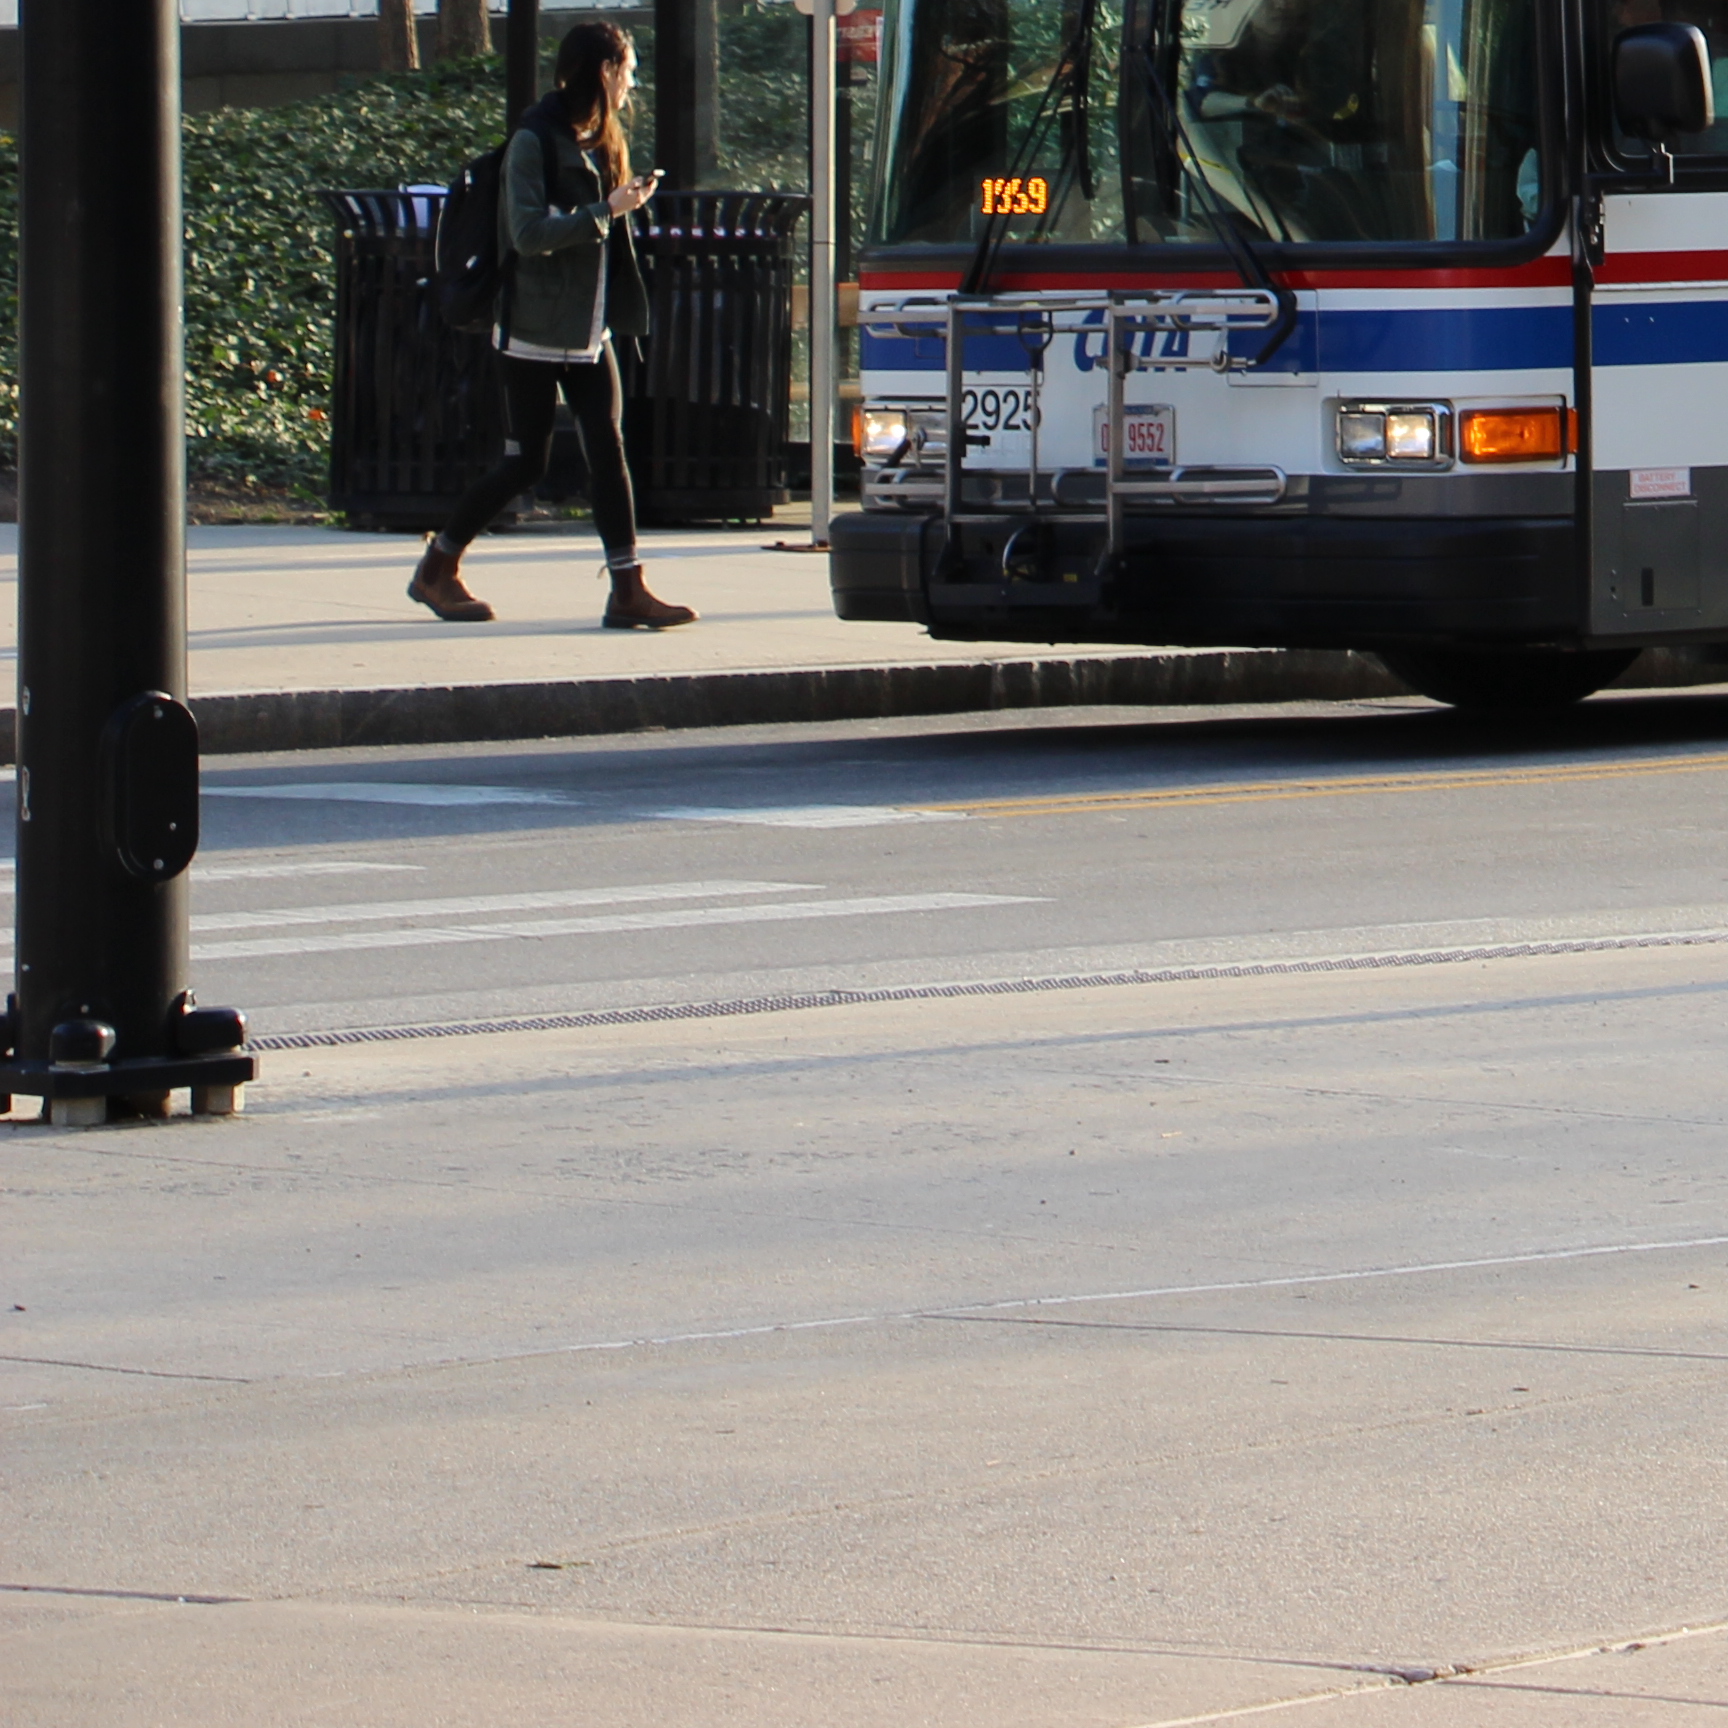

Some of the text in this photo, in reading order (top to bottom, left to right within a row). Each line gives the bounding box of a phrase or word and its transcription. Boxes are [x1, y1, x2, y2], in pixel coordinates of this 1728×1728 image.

[962, 389, 1041, 432] 2925
[1127, 422, 1165, 453] 9552
[1634, 482, 1686, 492] DISCONNECT
[1639, 472, 1676, 482] BATTERY
